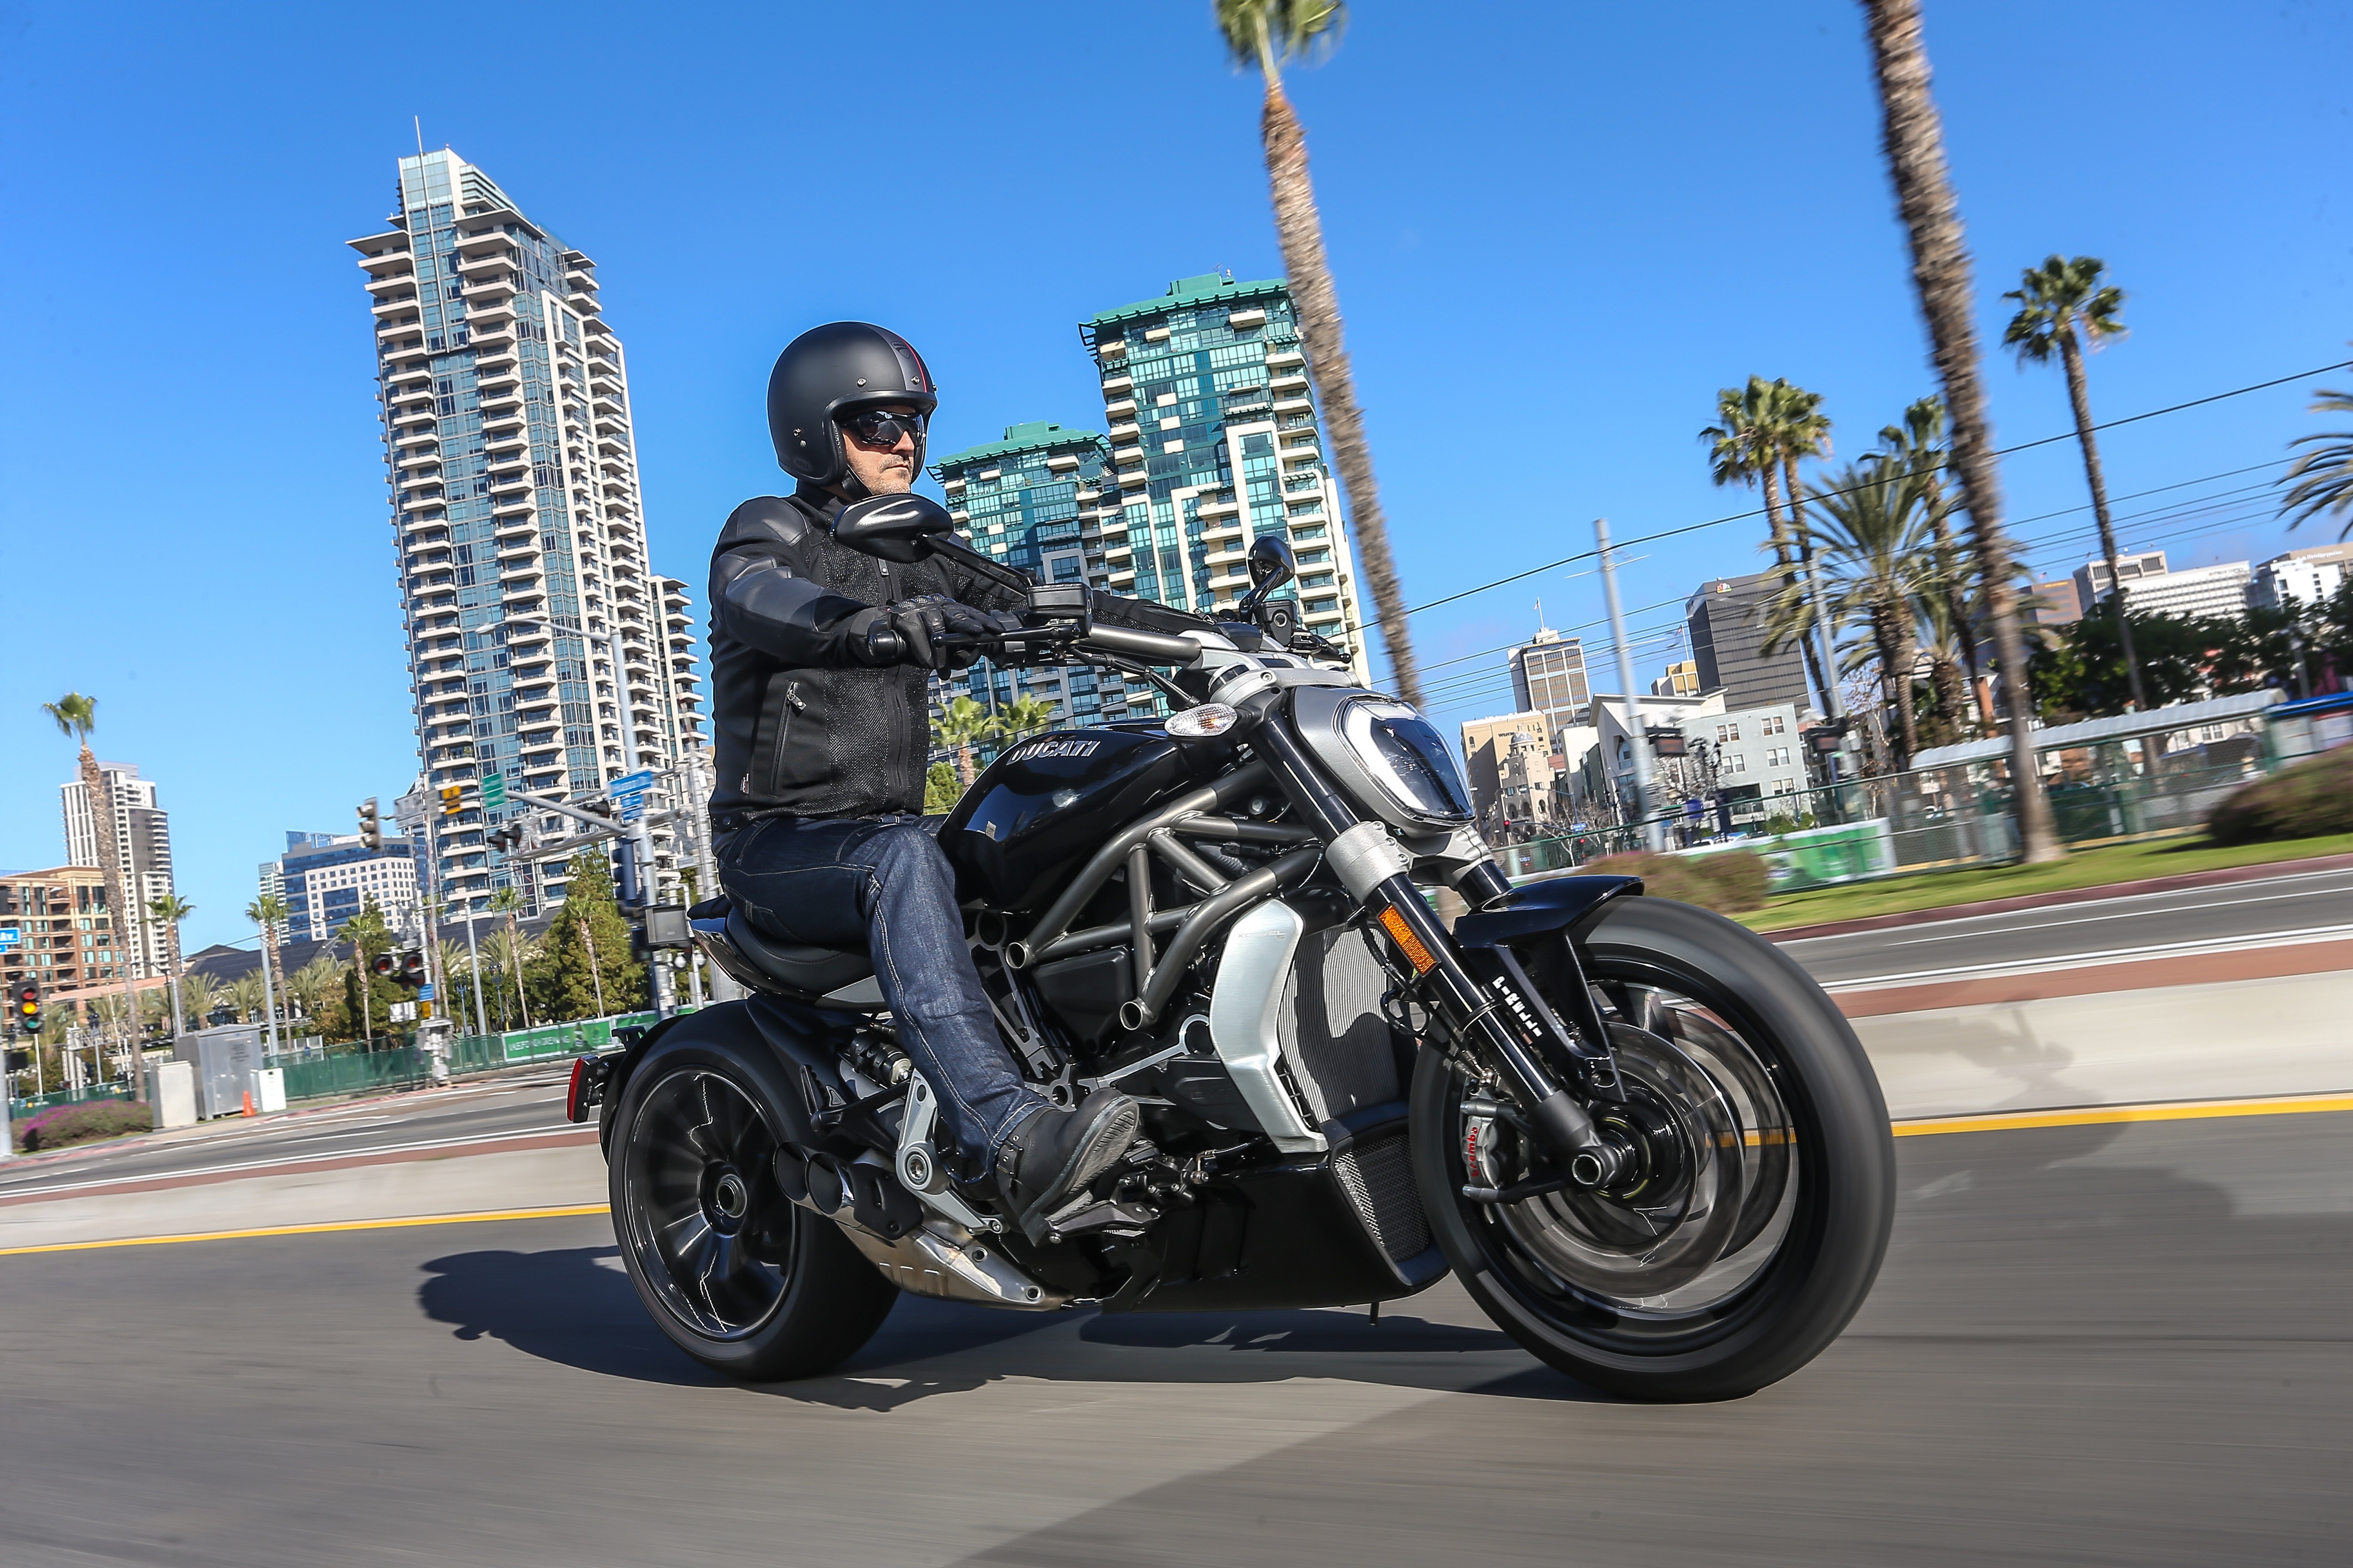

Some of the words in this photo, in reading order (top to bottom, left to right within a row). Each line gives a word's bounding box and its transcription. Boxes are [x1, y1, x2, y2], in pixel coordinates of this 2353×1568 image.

[1006, 740, 1101, 766] DUCATI
[1238, 930, 1286, 938] XDVEL
[1492, 976, 1543, 1037] PIRELLI
[1467, 1126, 1479, 1177] brembo
